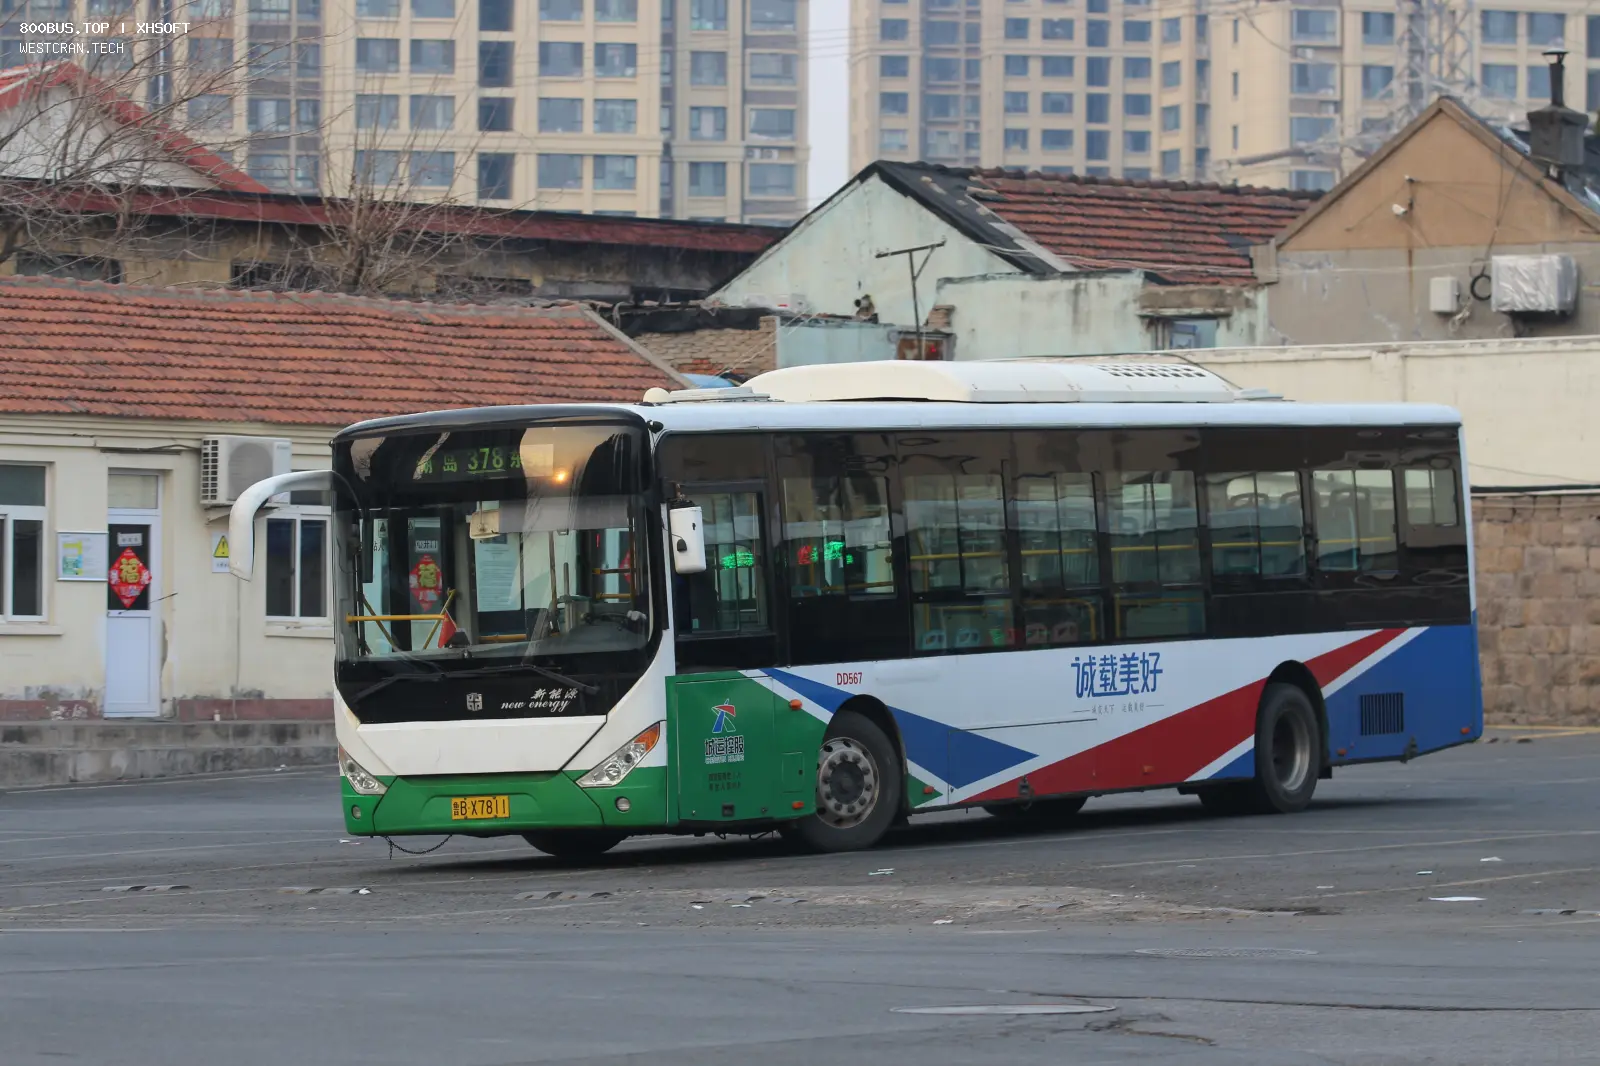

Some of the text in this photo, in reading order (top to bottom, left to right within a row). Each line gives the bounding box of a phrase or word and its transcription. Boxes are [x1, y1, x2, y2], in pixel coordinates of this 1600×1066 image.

[467, 447, 504, 471] 378
[119, 558, 140, 584] 福
[836, 672, 863, 685] DD567
[1070, 651, 1163, 698] 诚载美好
[530, 687, 579, 701] 新能源
[500, 700, 571, 712] new energy
[704, 734, 745, 757] 城运控股
